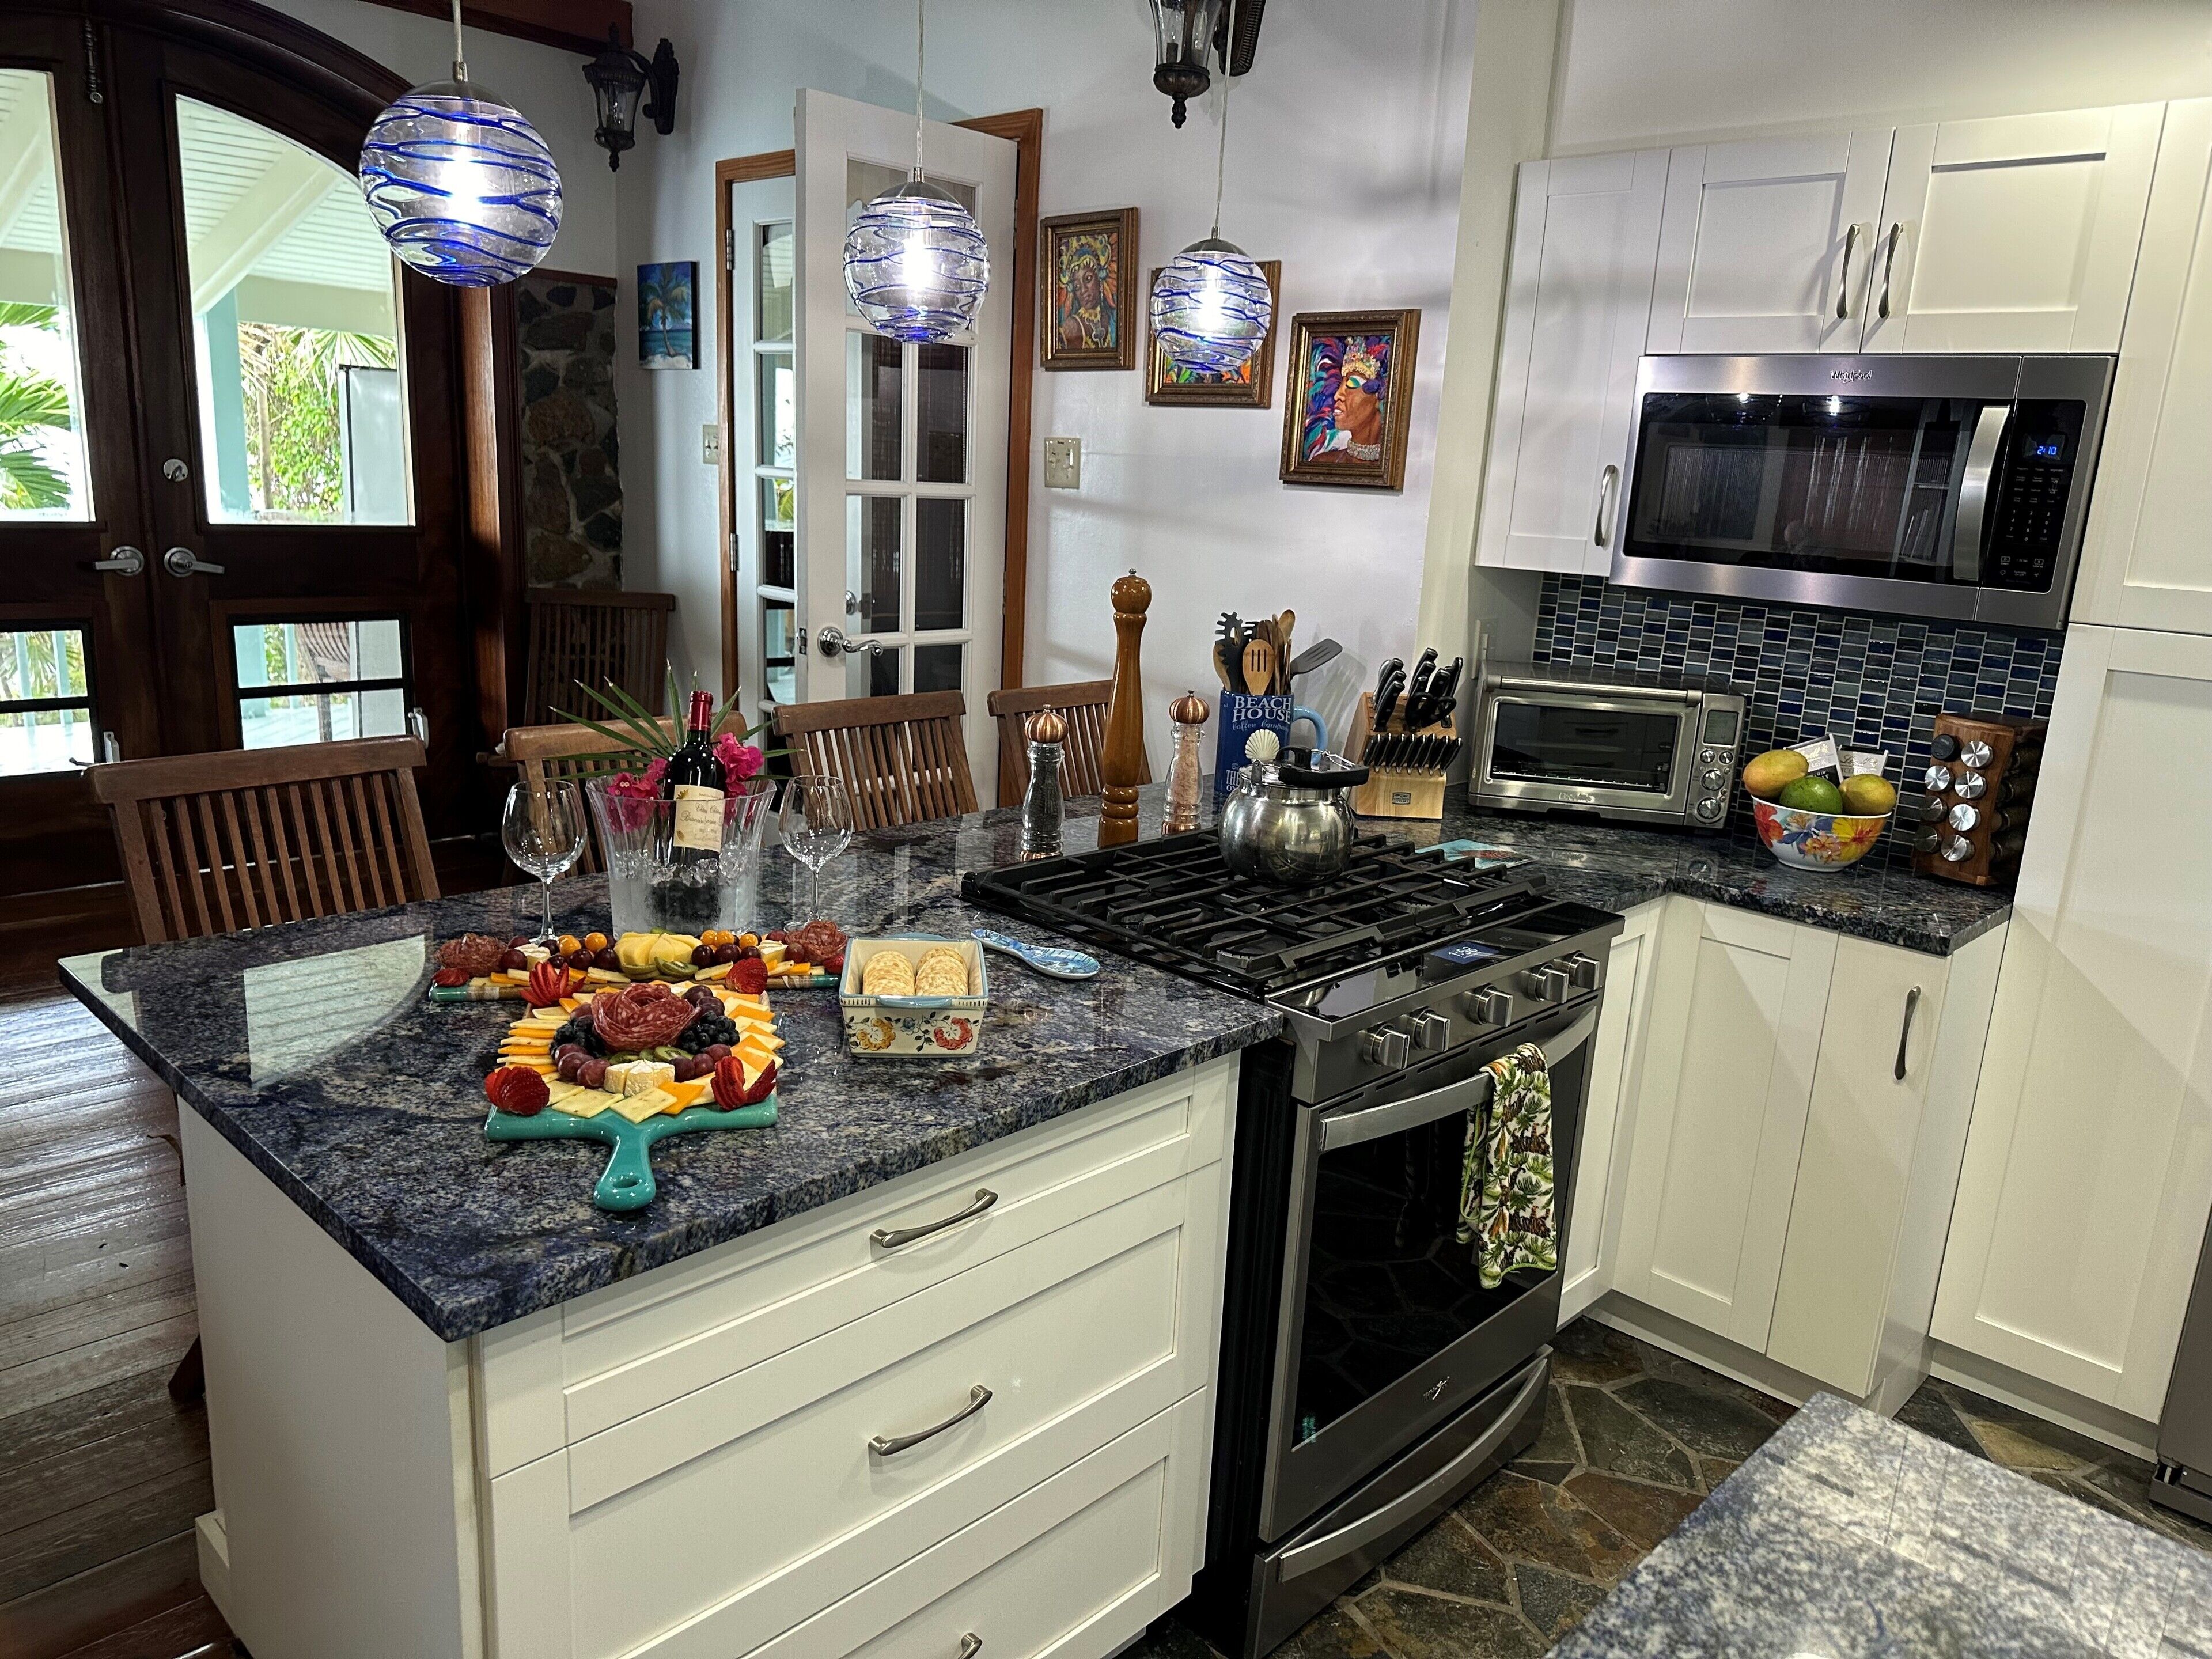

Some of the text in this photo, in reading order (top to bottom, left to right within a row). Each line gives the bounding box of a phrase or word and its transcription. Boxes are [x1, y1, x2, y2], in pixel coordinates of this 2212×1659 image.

[1830, 369, 1873, 382] Whirlpool
[2037, 446, 2057, 455] 2:10
[1234, 696, 1291, 710] BEACH
[1232, 708, 1290, 724] HOUSE
[1232, 720, 1256, 732] Coffee
[1448, 946, 1478, 957] 1:58
